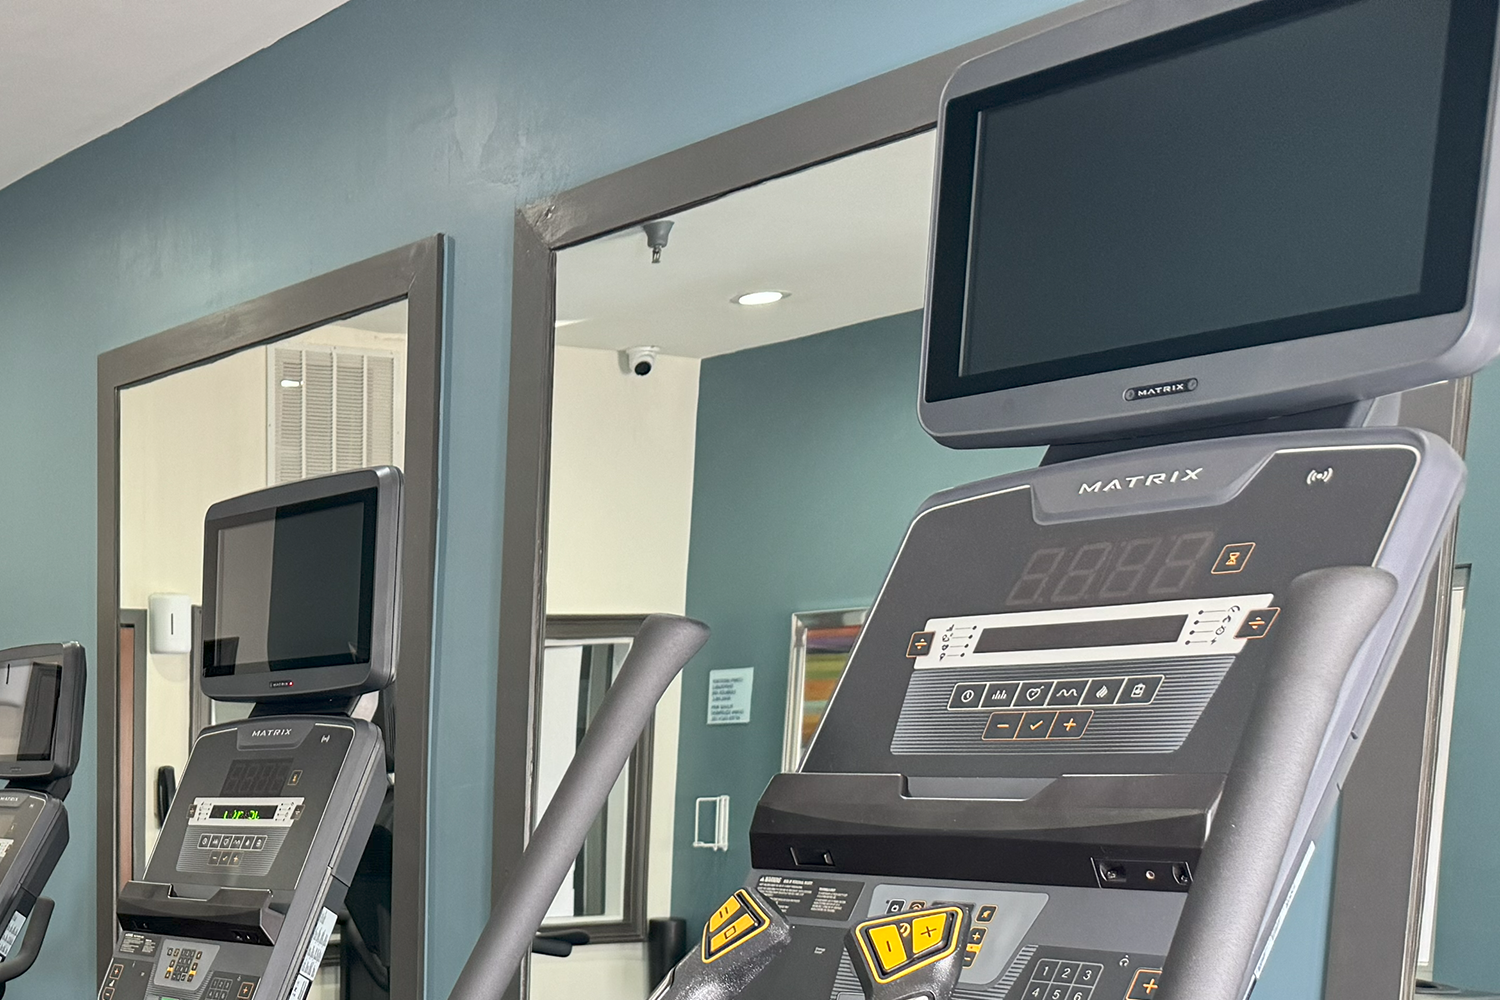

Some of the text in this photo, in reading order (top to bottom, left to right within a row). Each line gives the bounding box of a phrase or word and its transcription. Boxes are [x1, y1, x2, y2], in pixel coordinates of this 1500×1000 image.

[1137, 383, 1184, 397] MATRIX
[1078, 467, 1203, 495] MATRIX
[251, 728, 292, 737] MATRIX
[1042, 966, 1092, 981] 1 2 3
[1031, 987, 1040, 998] 4
[1052, 989, 1061, 1000] 5
